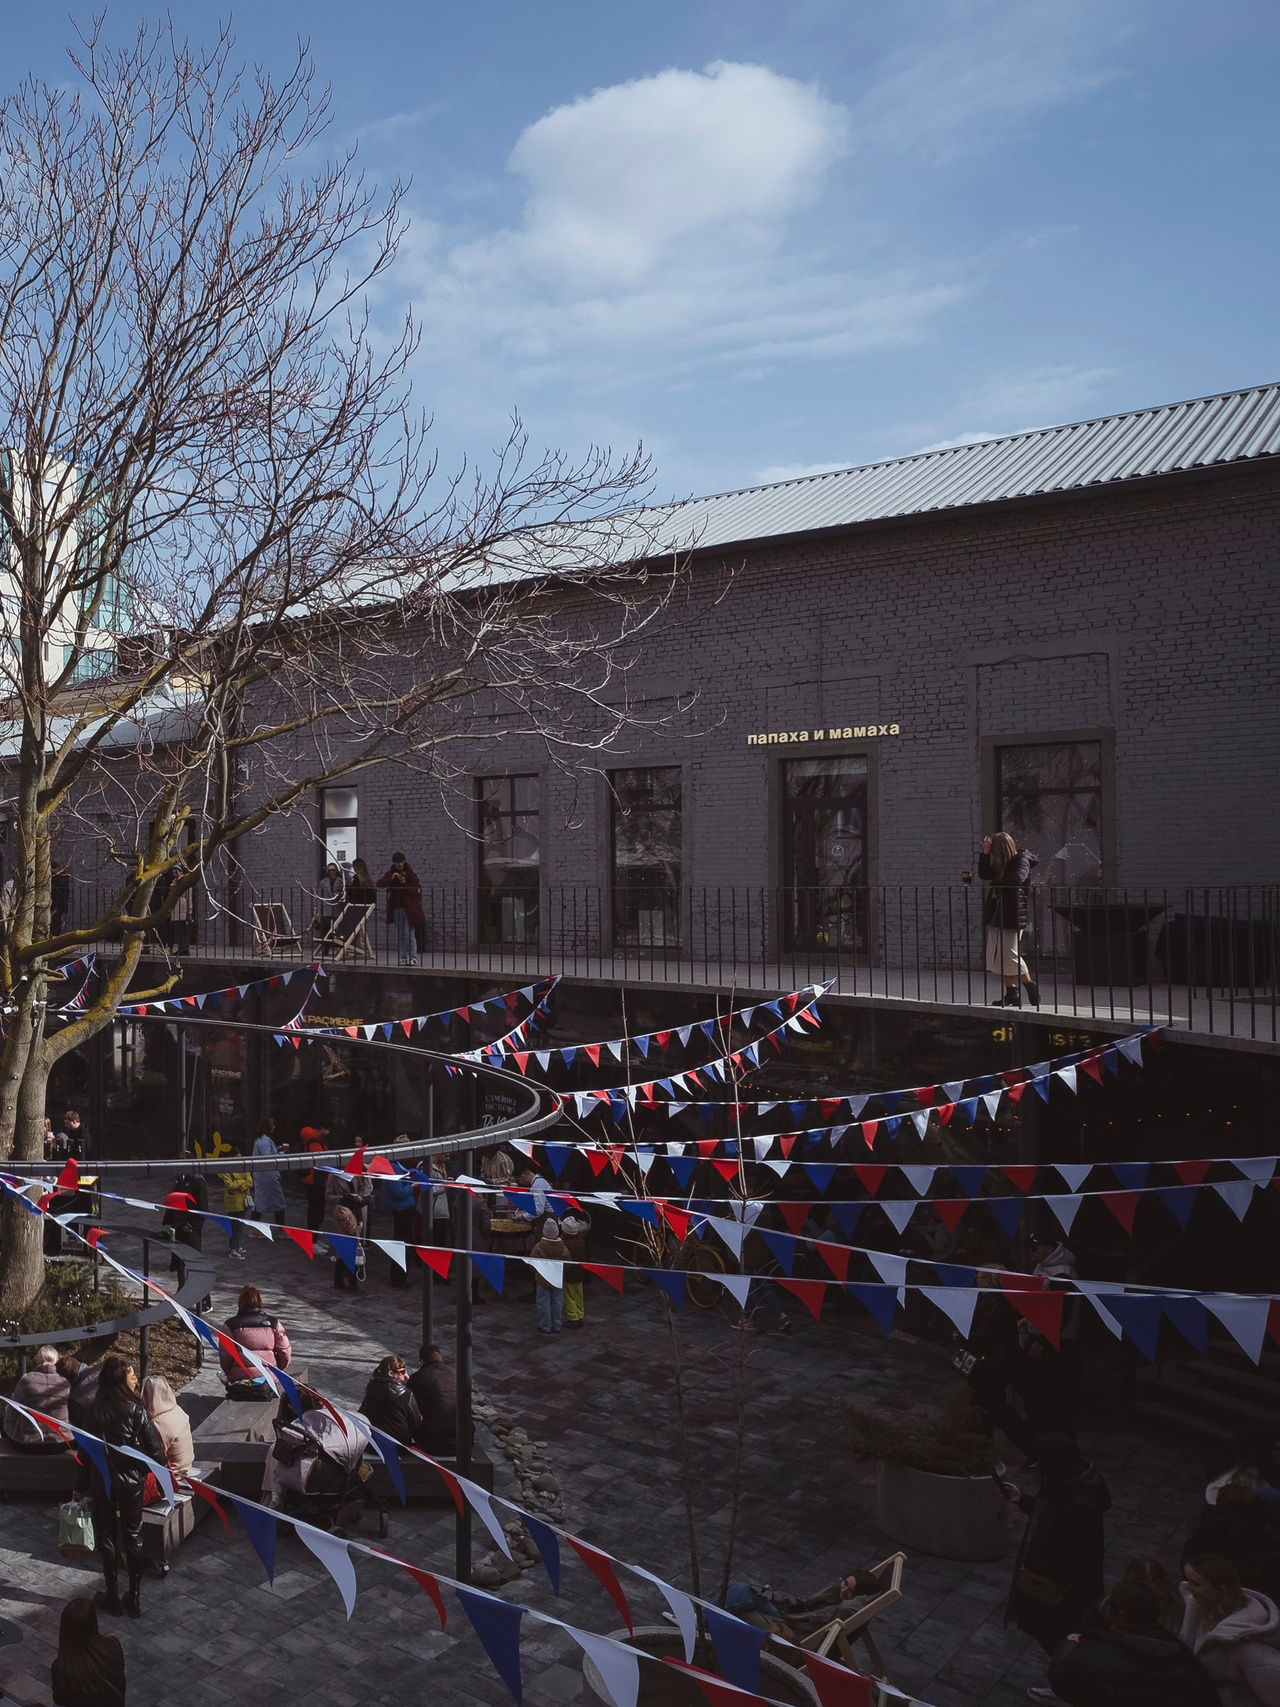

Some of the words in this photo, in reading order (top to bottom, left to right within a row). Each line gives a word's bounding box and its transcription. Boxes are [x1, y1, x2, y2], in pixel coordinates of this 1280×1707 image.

[747, 731, 809, 745] папаха
[814, 729, 824, 741] и
[829, 723, 900, 740] мамаха
[303, 1014, 364, 1027] КРАСИВЫЕ
